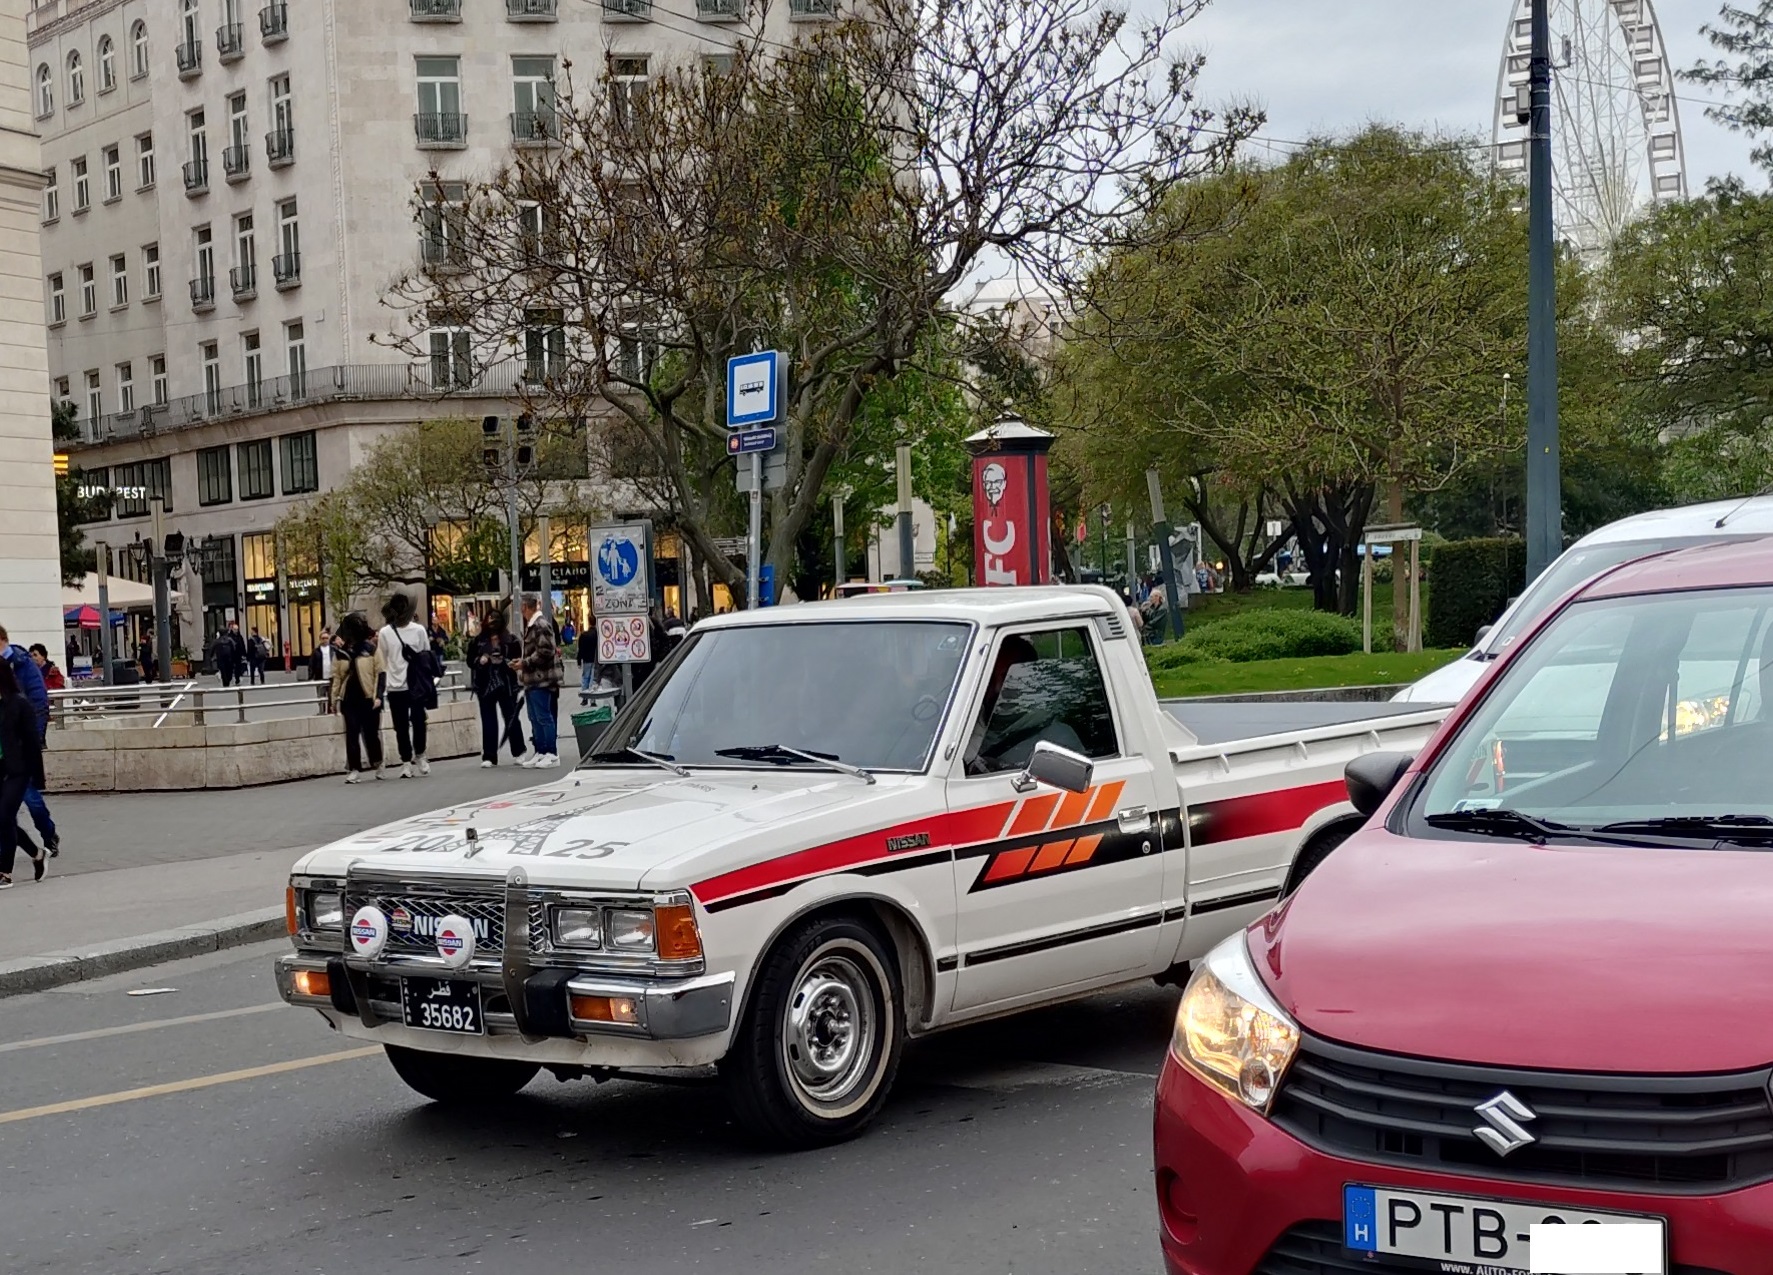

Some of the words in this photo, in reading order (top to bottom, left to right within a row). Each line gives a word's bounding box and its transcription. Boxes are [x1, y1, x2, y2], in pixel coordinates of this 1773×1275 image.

[77, 485, 146, 500] BUDPEST
[983, 520, 1018, 587] FC
[528, 567, 587, 577] MCIANO
[381, 834, 455, 852] 20
[543, 838, 631, 860] 25
[886, 832, 932, 852] NISSAN
[352, 926, 377, 937] NISSAN
[427, 980, 452, 999] قطر
[420, 1002, 476, 1031] 35682
[1354, 1222, 1369, 1242] H
